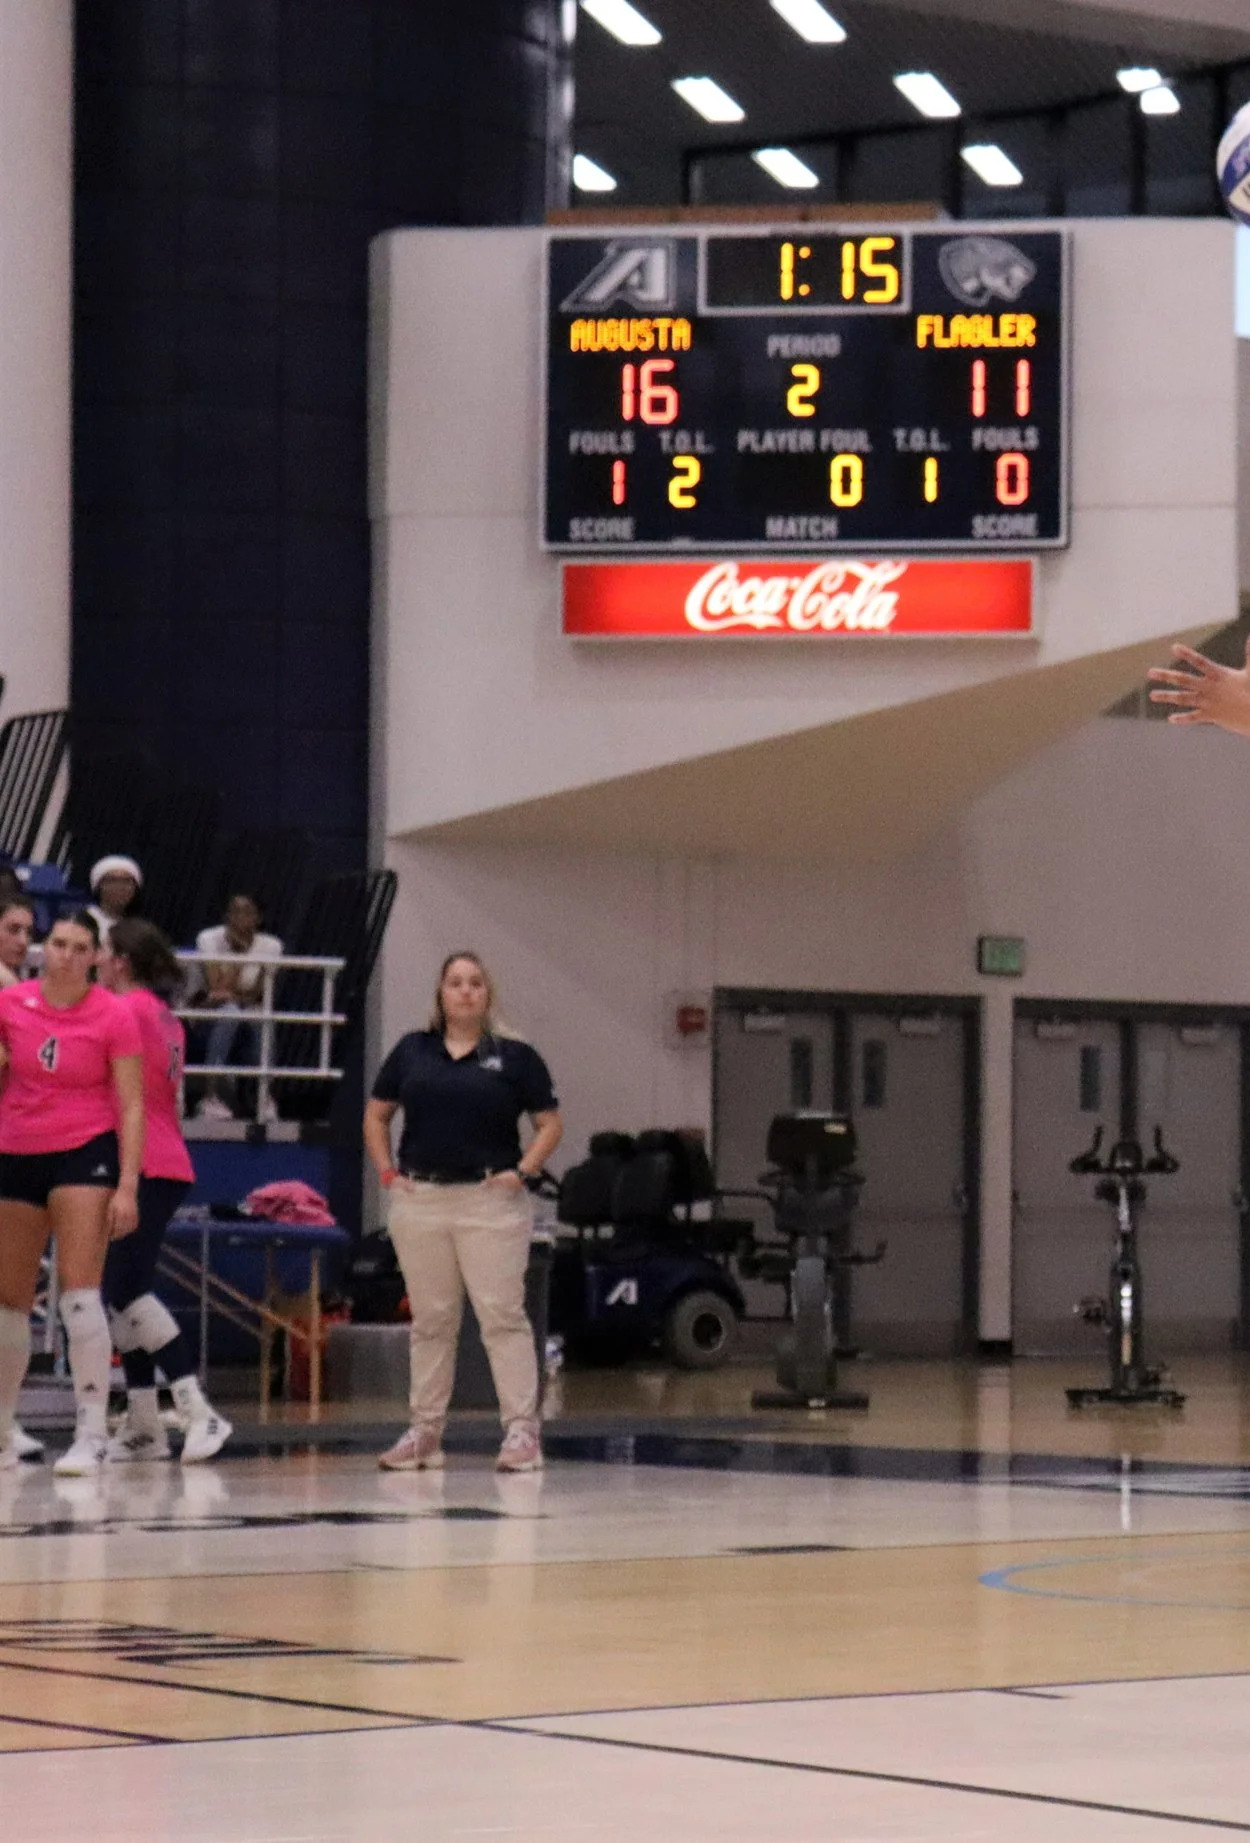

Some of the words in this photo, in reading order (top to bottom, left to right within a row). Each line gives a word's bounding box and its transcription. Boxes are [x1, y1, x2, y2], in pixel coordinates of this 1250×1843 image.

[570, 318, 692, 352] AUGUSTA
[767, 334, 841, 358] PERIOD
[917, 313, 1037, 348] FLAGLER
[622, 359, 678, 425] 16
[787, 363, 820, 417] 2
[971, 359, 1031, 418] 11
[569, 430, 635, 453] FOULS
[737, 429, 814, 453] PLAYER
[820, 428, 871, 453] FOUL
[972, 426, 1039, 450] FOULS
[612, 459, 626, 505] 1
[668, 455, 701, 508] 2
[830, 453, 863, 507] 0
[924, 456, 938, 503] 1
[995, 452, 1029, 506] 0
[569, 517, 636, 541] SCORE
[766, 515, 839, 539] MATCH
[972, 513, 1038, 538] SCORE
[684, 561, 909, 632] Coca-Cola
[38, 1037, 58, 1072] 4
